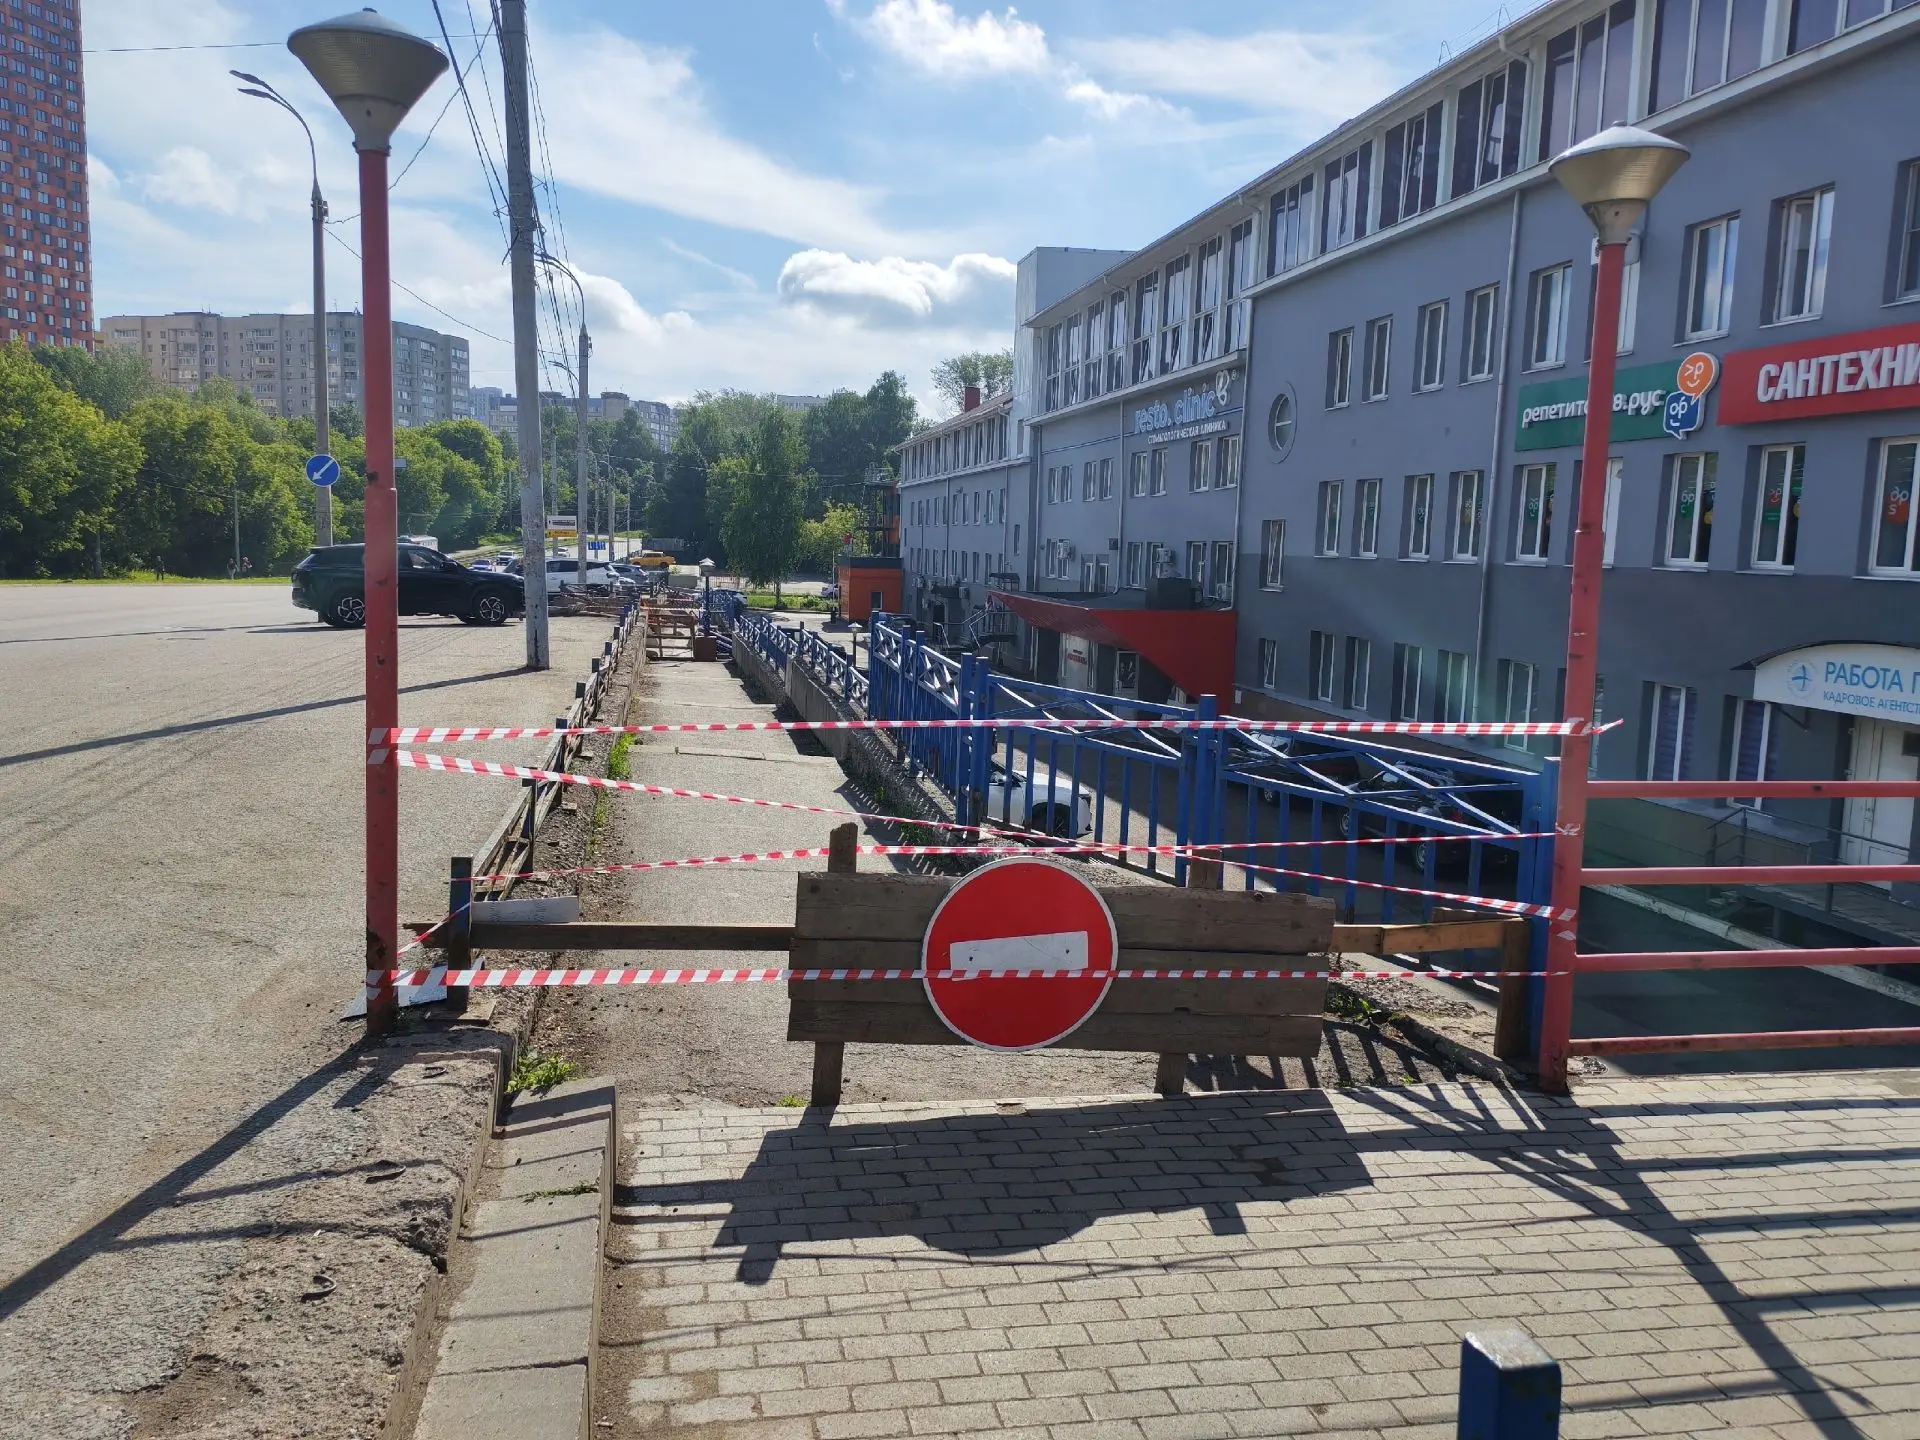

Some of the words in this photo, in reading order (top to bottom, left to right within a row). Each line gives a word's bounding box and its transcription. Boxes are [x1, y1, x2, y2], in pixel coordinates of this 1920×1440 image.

[1757, 343, 1920, 403] САНТЕХНИ
[1175, 382, 1216, 425] clinic
[1521, 389, 1666, 429] репетитв.рус
[1824, 661, 1904, 693] РАБОТА
[1823, 690, 1876, 708] КАДРОВОЕ
[1877, 698, 1920, 715] АГЕНТСТ
